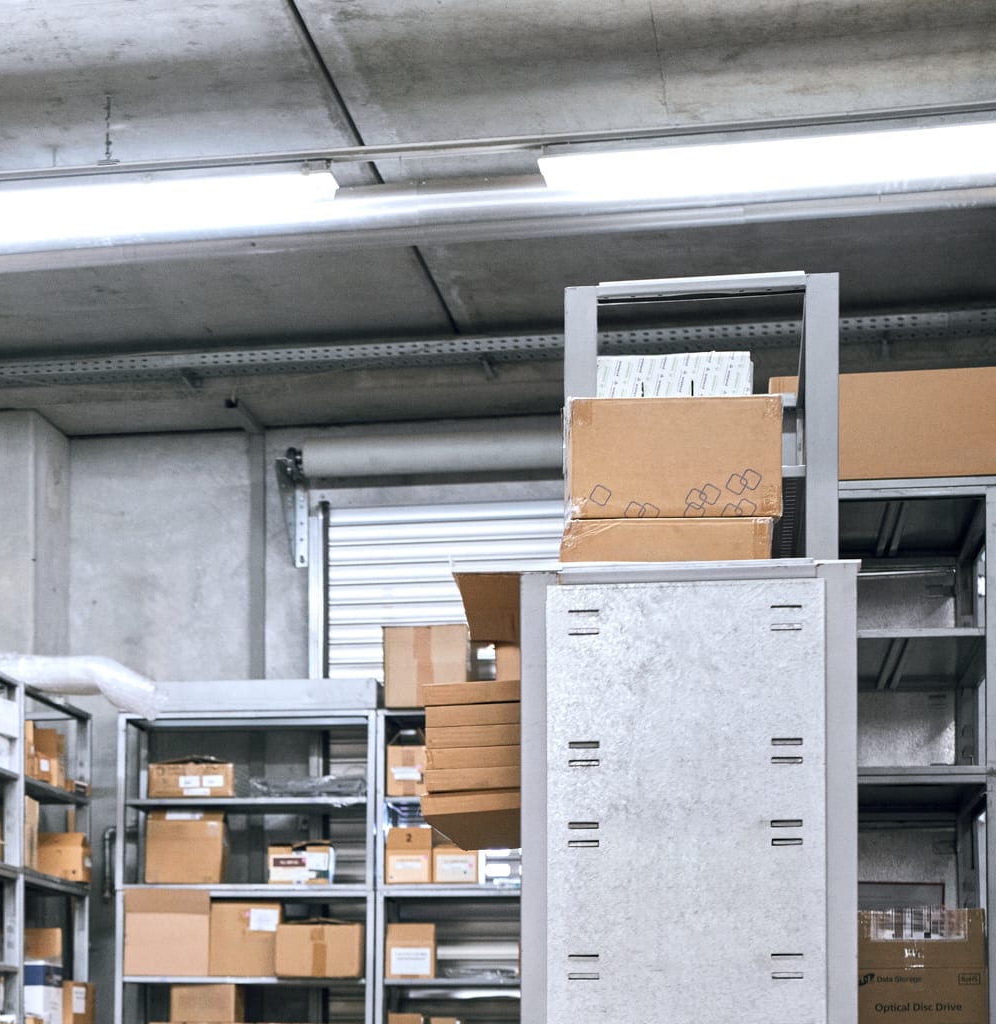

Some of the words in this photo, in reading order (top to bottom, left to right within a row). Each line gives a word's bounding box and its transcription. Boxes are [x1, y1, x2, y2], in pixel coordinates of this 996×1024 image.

[894, 975, 922, 984] Storage
[875, 1002, 910, 1014] Optical
[912, 1002, 934, 1012] Disc
[935, 1002, 963, 1012] Drive
